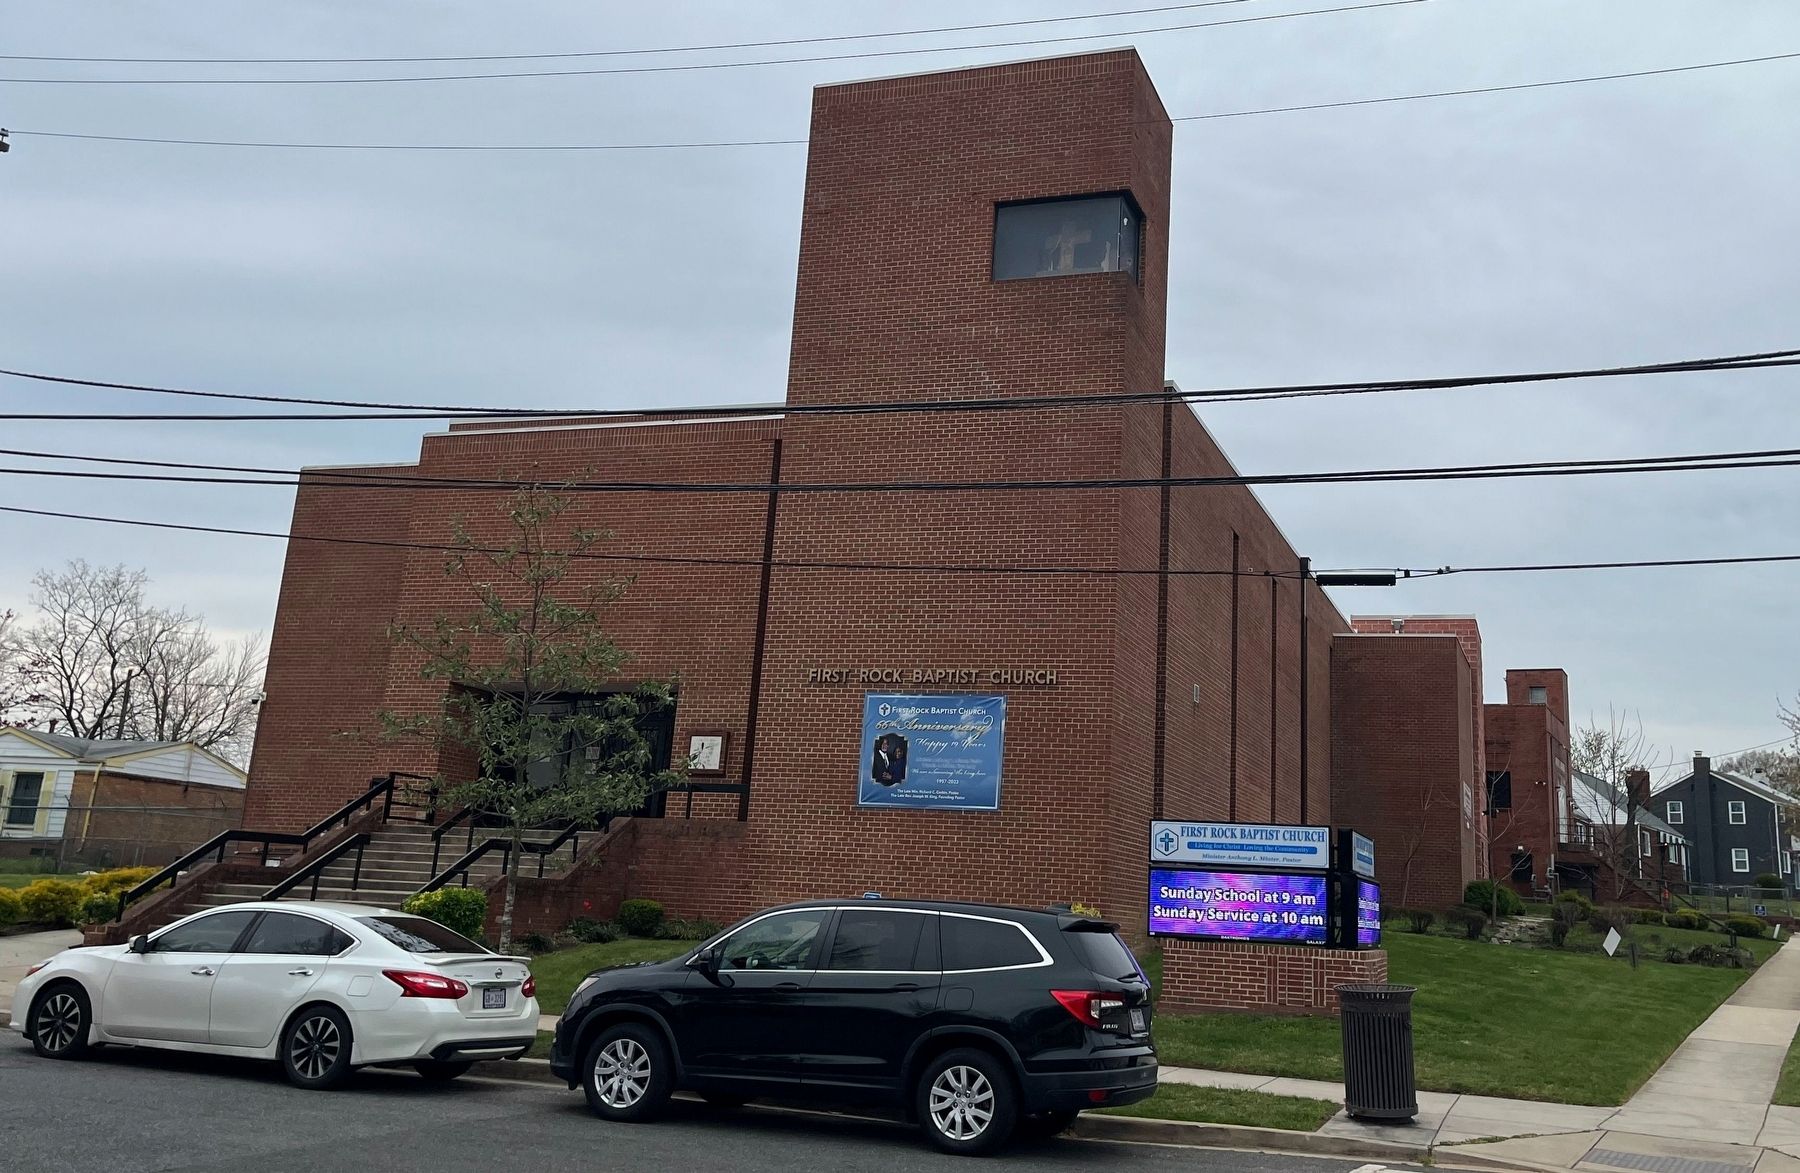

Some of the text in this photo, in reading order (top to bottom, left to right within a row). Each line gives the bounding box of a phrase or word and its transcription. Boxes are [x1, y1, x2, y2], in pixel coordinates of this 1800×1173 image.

[809, 668, 1058, 685] FIRST ROCK BAPTIST CHURCH
[911, 706, 930, 715] ROCK
[931, 706, 957, 715] BAPTIST
[958, 707, 986, 716] CHURCH
[875, 715, 994, 741] 66th Anniversary
[915, 738, 948, 756] Happy
[960, 739, 986, 752] Years
[1181, 826, 1325, 843] FIRST ROCK BAPTIST CHURCH
[1194, 842, 1213, 850] Living
[1243, 844, 1263, 852] Loving
[1275, 846, 1309, 855] Community
[1160, 886, 1316, 906] Sunday School at 9 am
[1153, 905, 1323, 926] Sunday Service at 10 am
